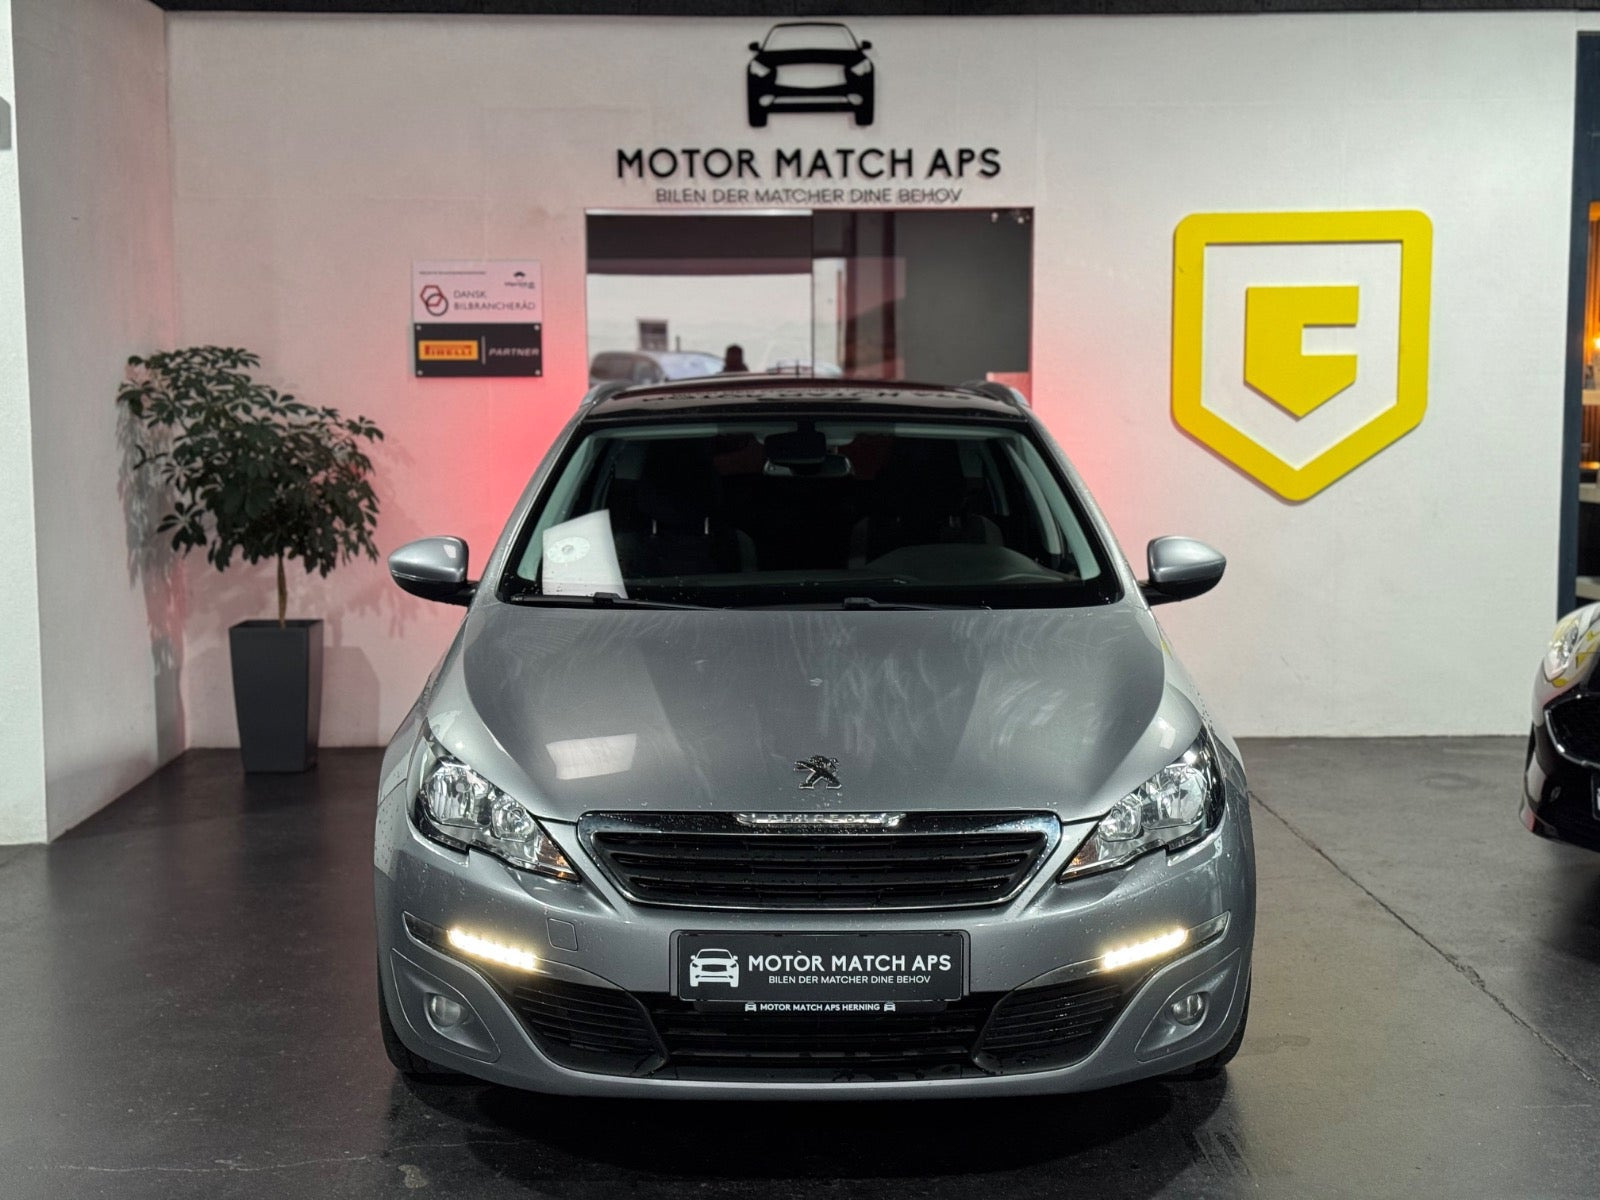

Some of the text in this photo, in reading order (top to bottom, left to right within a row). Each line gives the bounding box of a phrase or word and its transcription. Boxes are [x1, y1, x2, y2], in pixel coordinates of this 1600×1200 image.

[616, 148, 1002, 178] MOTOR MATCH APS
[655, 188, 963, 203] BILEN DER MATCHER DINE BEHOV
[453, 290, 487, 299] DANSK
[488, 348, 540, 356] PARTNER
[748, 955, 951, 972] MOTOR MATCH APS
[768, 975, 931, 984] BILEN DER MATCHER DINE BEHOV
[760, 1003, 880, 1011] MOTOR MATCH APS HERNING
